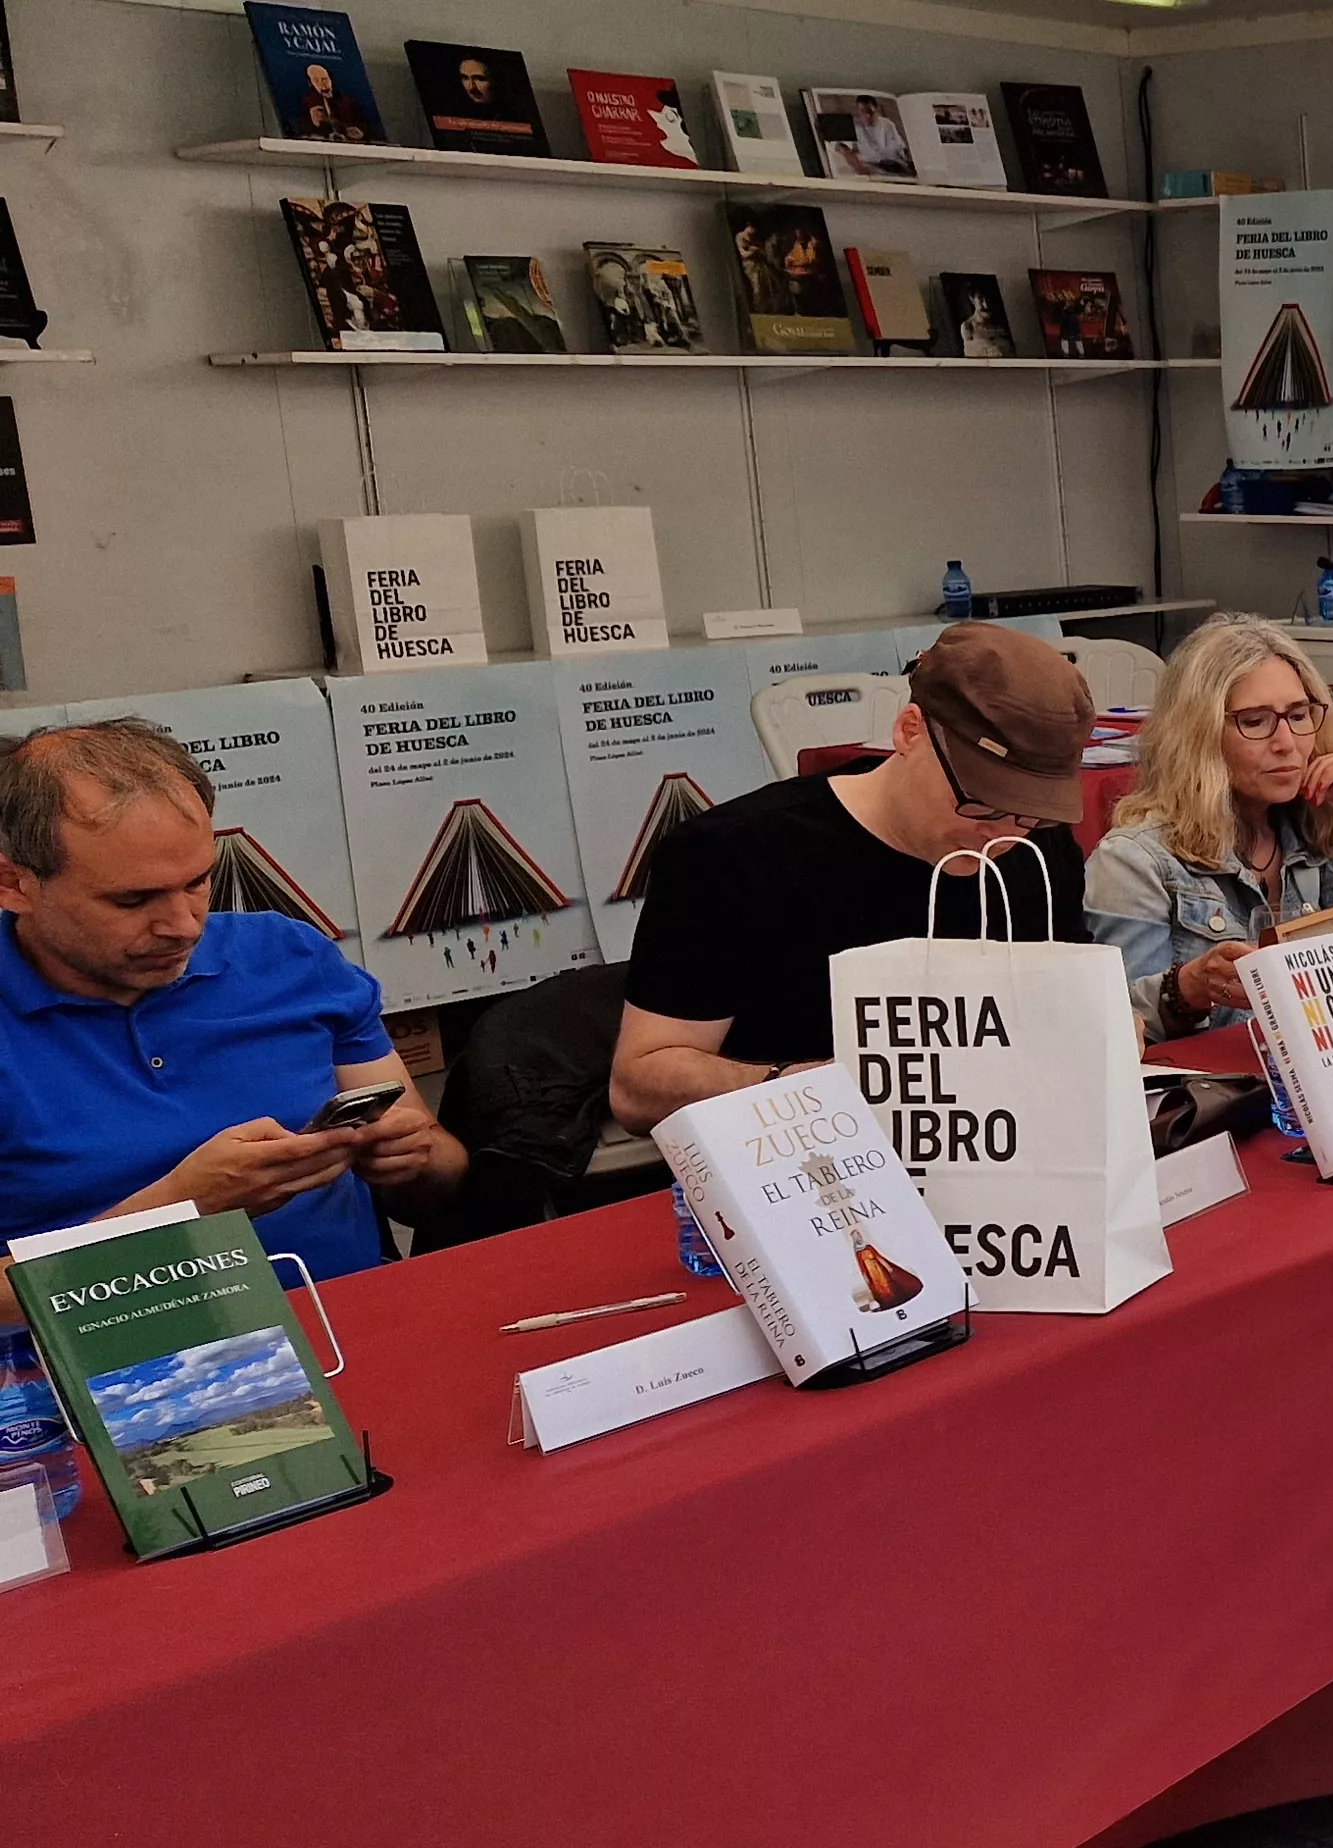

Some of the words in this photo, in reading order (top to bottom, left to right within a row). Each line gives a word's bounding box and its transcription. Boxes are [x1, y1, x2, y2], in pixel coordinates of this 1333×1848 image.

[277, 20, 337, 40] RAMÓN
[293, 37, 339, 54] CAJAL
[1236, 231, 1269, 244] FERIA
[1271, 231, 1292, 243] DEL
[1294, 230, 1328, 242] LIBRO
[1235, 249, 1251, 260] DE
[1253, 247, 1296, 259] HUESCA
[555, 558, 604, 576] FERIA
[367, 569, 421, 588] FERIA
[557, 577, 590, 593] DEL
[370, 589, 405, 606] DEL
[559, 592, 610, 611] LIBRO
[372, 605, 427, 624] LIBRO
[561, 611, 584, 627] DE
[374, 625, 399, 642] DE
[564, 624, 636, 643] HUESCA
[376, 638, 454, 660] HUESCA
[769, 664, 782, 674] 40
[783, 661, 818, 673] Edición
[579, 683, 592, 693] 40
[595, 680, 633, 691] Edición
[360, 704, 375, 714] 40
[379, 700, 424, 713] Edición
[582, 698, 632, 714] FERIA
[634, 694, 665, 709] DEL
[668, 689, 715, 705] LIBRO
[806, 690, 853, 707] UESCA
[363, 720, 422, 737] FERIA
[425, 715, 461, 731] DEL
[464, 710, 517, 727] LIBRO
[585, 719, 607, 732] DE
[610, 711, 673, 730] HUESCA
[220, 731, 281, 751] LIBRO
[365, 741, 392, 757] DE
[395, 734, 469, 754] HUESCA
[218, 781, 243, 792] junio
[245, 779, 256, 787] de
[257, 774, 281, 785] 2024
[1291, 970, 1317, 1000] NI
[854, 996, 1011, 1048] FERIA
[1301, 998, 1328, 1027] NI
[1321, 1058, 1333, 1067] LA
[859, 1053, 957, 1105] DEL
[751, 1086, 823, 1129] LUIS
[745, 1111, 860, 1168] ZUECO
[892, 1109, 1017, 1162] IBRO
[664, 1139, 705, 1203] ZUECO
[683, 1141, 713, 1184] LUIS
[760, 1183, 791, 1205] EL
[788, 1149, 886, 1194] TABLERO
[820, 1191, 837, 1207] DE
[808, 1198, 887, 1237] REINA
[944, 1224, 1080, 1278] ESCA
[49, 1248, 249, 1314] EVOCACIONES
[77, 1312, 130, 1334] IGNACIO
[130, 1294, 202, 1320] ALMUDÉVAR
[202, 1282, 250, 1301] ZAMORA
[733, 1261, 749, 1281] DE
[757, 1303, 786, 1349] REINA
[747, 1257, 761, 1275] EL
[757, 1276, 796, 1338] TABLERO
[635, 1384, 648, 1395] D.
[650, 1376, 673, 1390] Luis
[675, 1366, 705, 1383] Zueco
[232, 1477, 271, 1498] PIRINEO
